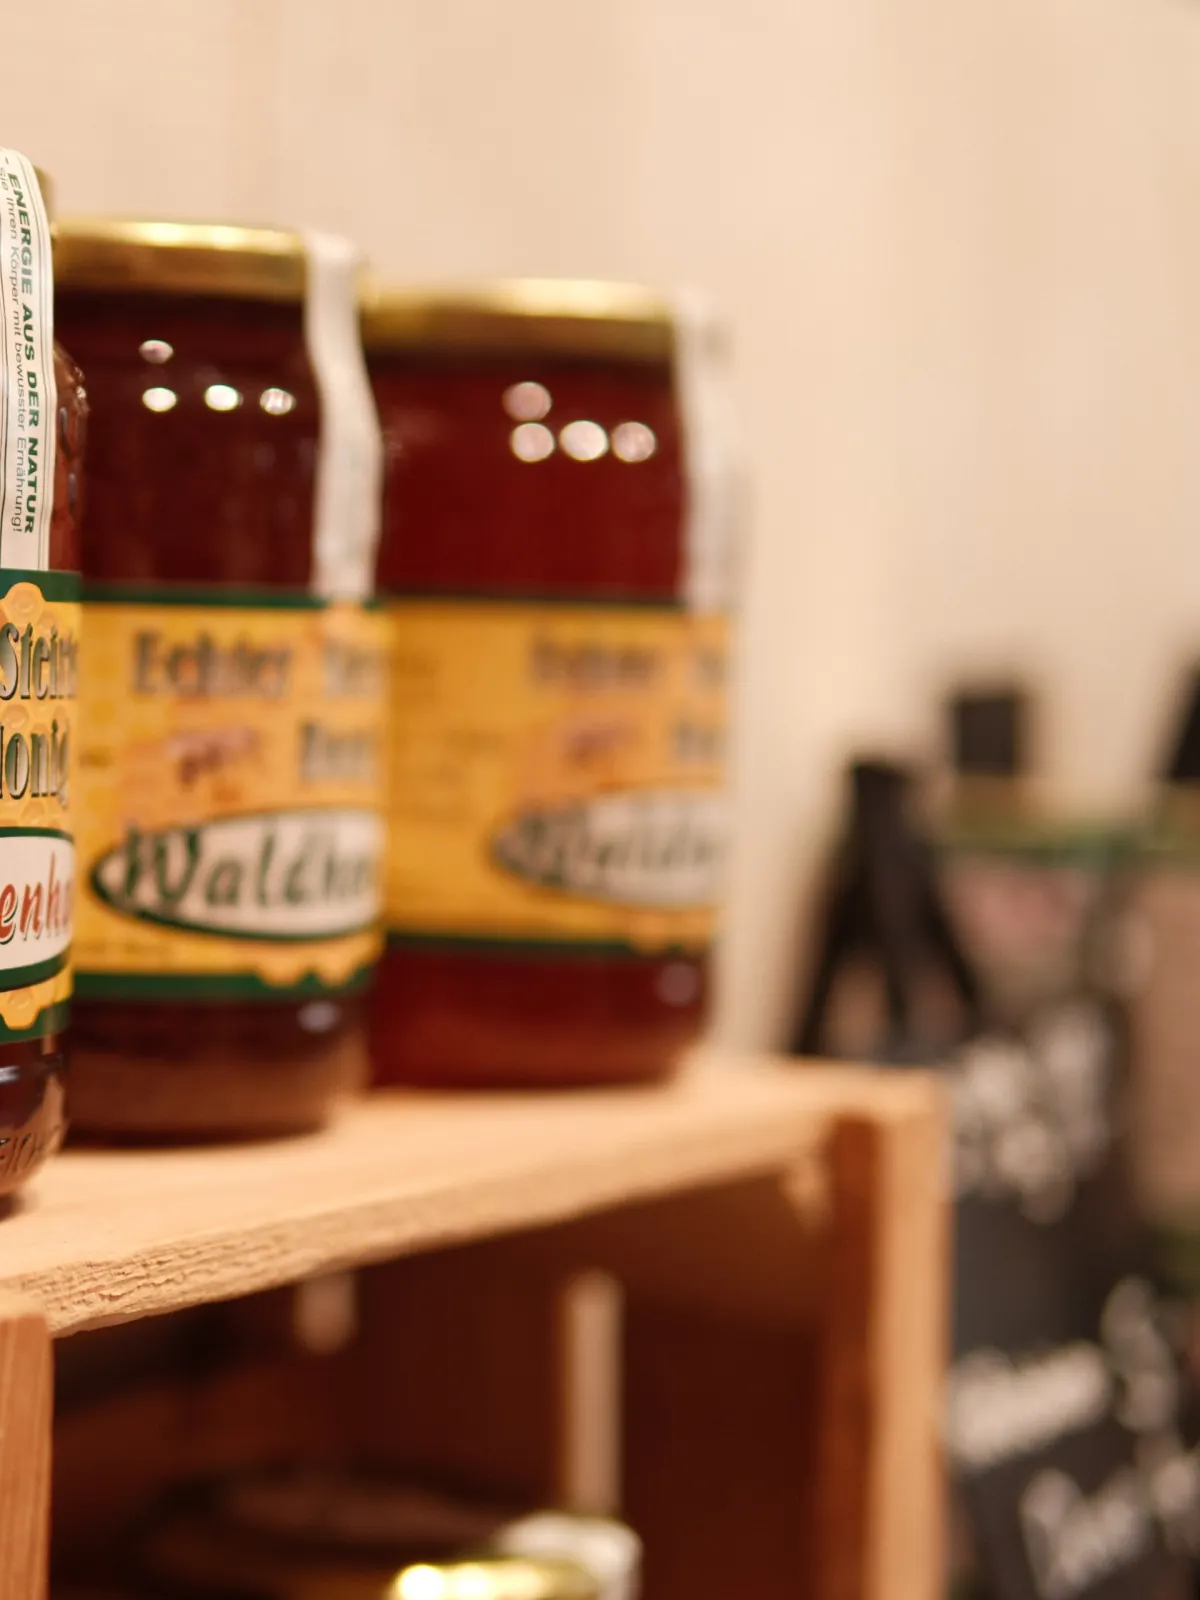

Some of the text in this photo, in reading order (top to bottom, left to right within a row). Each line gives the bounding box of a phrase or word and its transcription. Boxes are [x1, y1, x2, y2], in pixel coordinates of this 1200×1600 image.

[6, 196, 17, 238] Ihren
[7, 172, 34, 296] ENERGIE
[9, 246, 20, 307] Körper
[13, 310, 22, 338] mit
[21, 302, 36, 362] AUS
[14, 342, 26, 432] bewusster
[26, 371, 40, 428] DER
[11, 437, 27, 532] Ernährung!
[24, 437, 40, 533] NATUR
